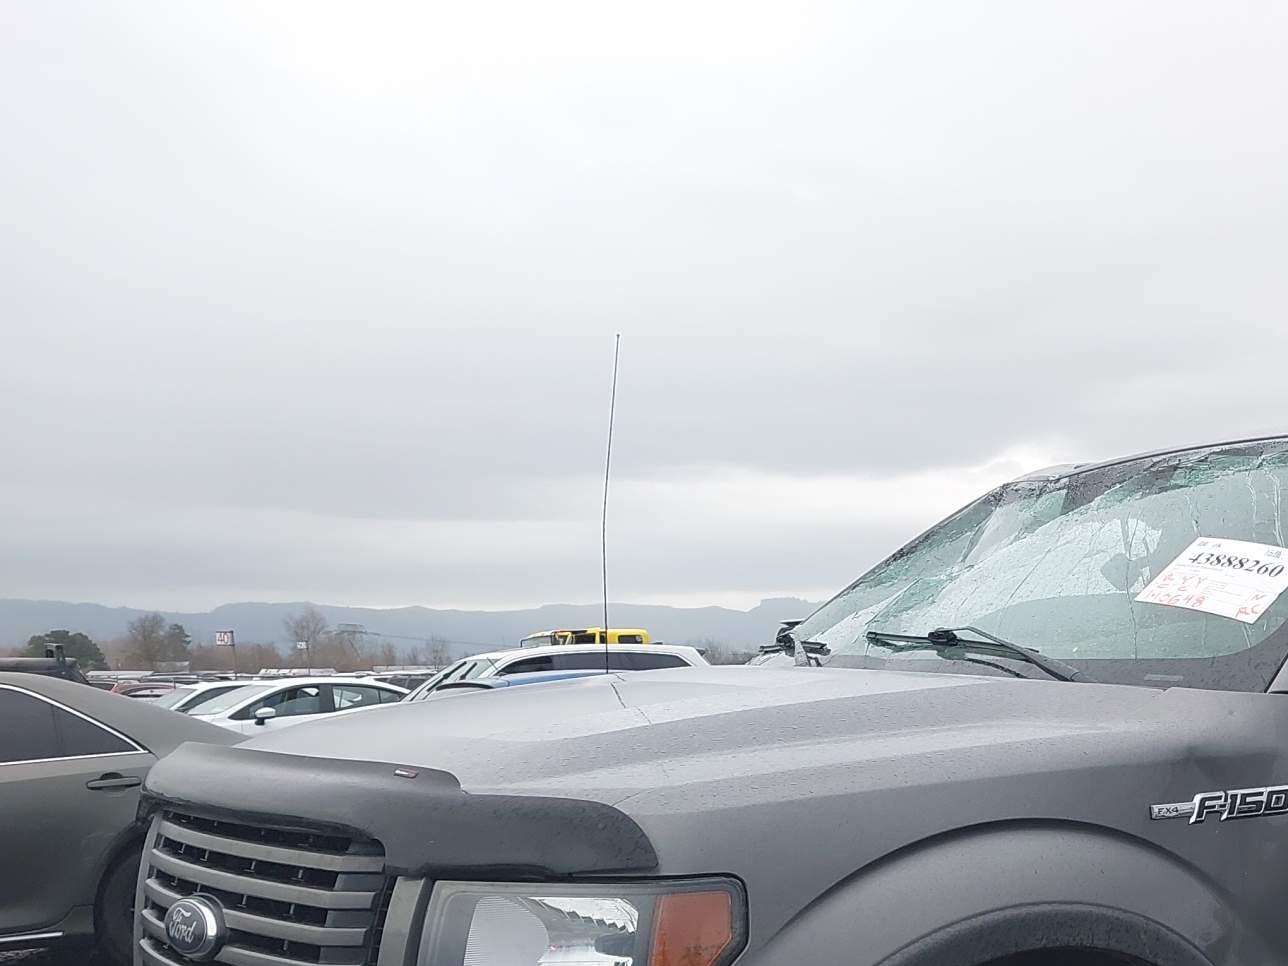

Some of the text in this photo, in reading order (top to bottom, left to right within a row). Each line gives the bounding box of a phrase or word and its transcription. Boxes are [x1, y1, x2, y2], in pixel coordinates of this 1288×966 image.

[1188, 551, 1285, 578] 43888260
[1157, 806, 1179, 815] FX4
[168, 907, 197, 944] Ford
